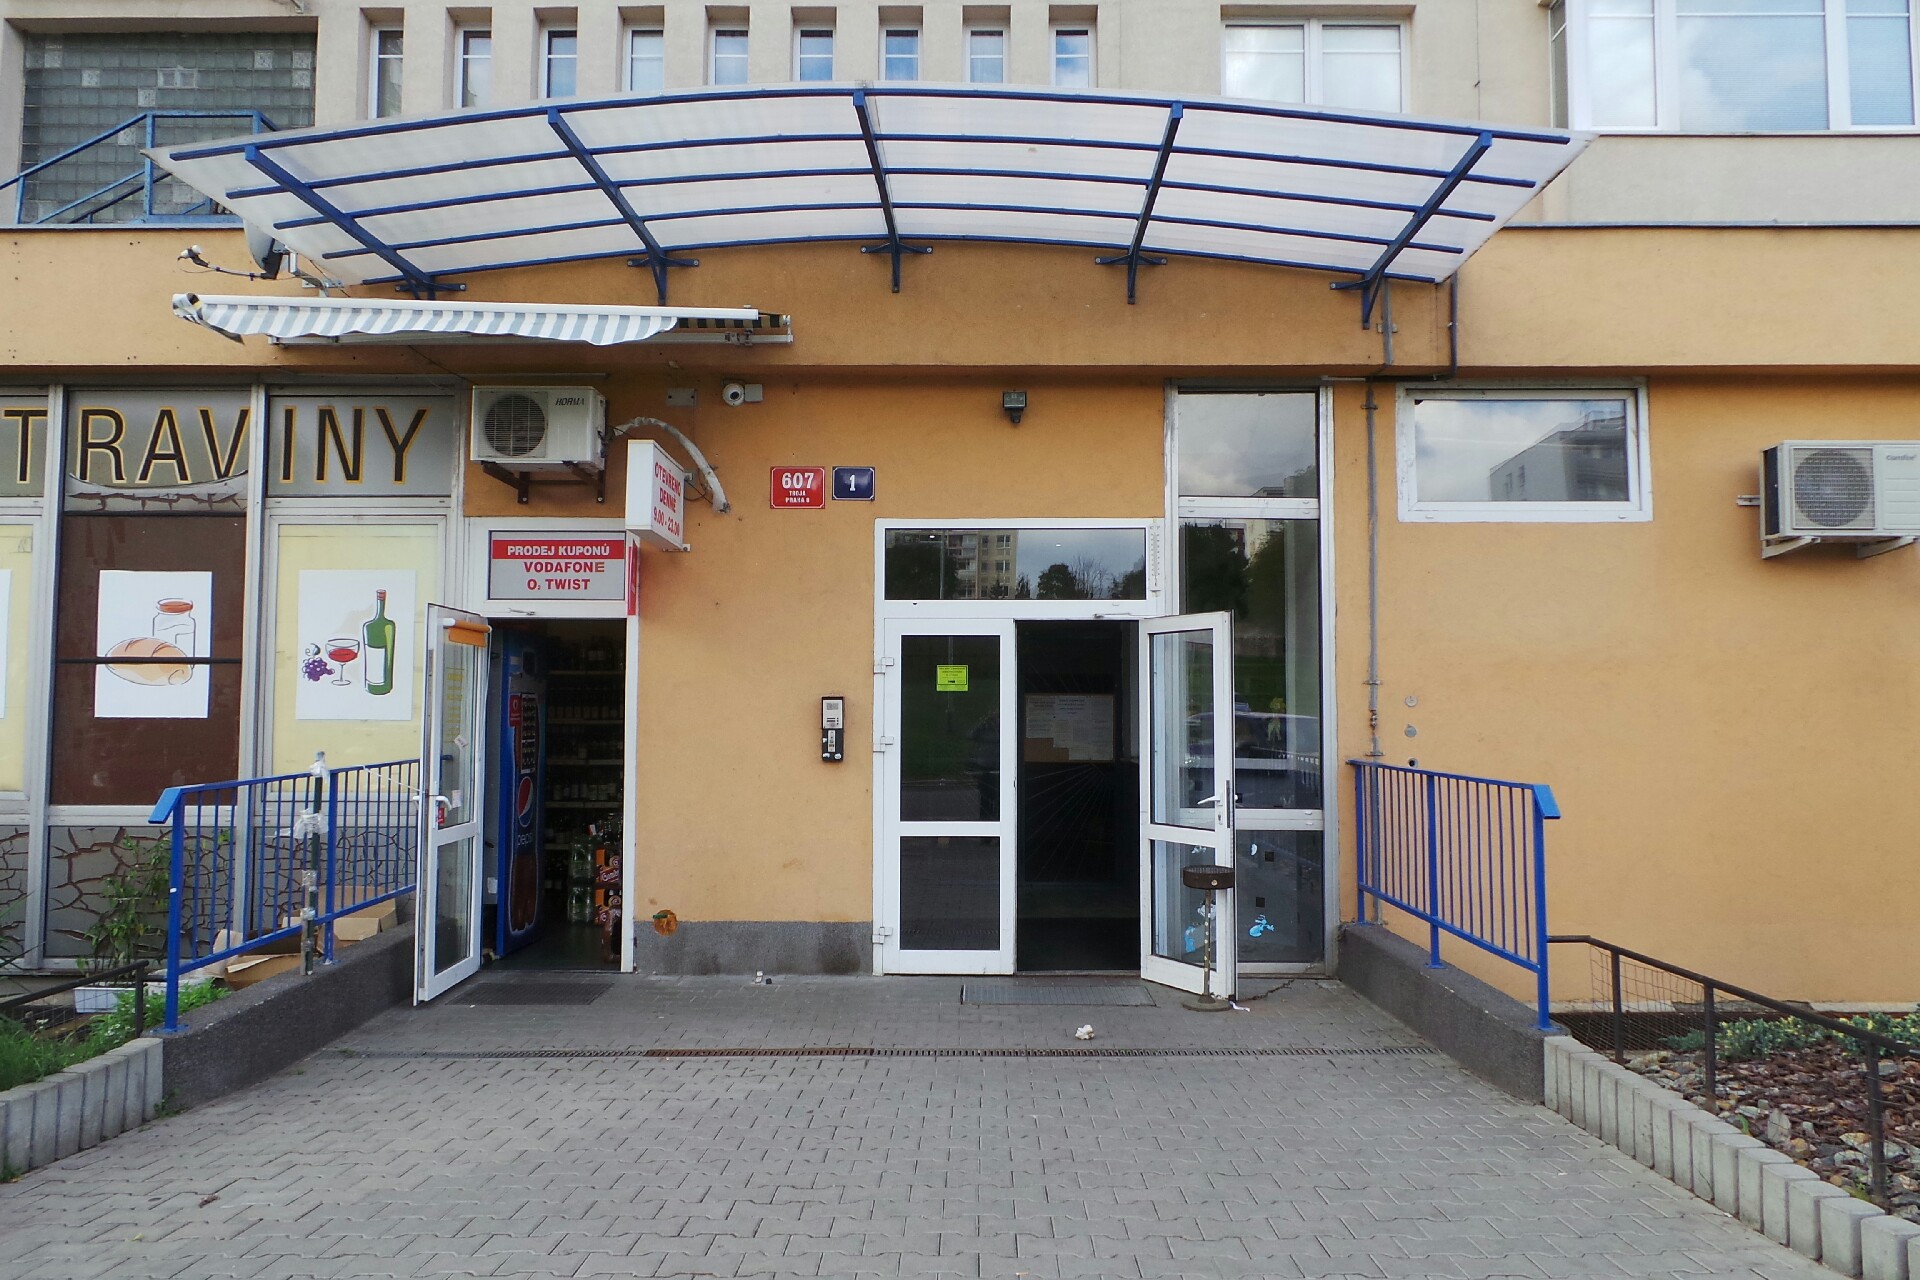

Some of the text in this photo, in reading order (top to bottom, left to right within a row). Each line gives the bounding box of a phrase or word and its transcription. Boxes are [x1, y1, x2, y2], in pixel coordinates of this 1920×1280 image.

[781, 472, 814, 489] 607
[849, 474, 856, 492] 1
[507, 543, 609, 556] PRODEJ KUPONŮ
[524, 561, 605, 573] VODAFONE
[545, 578, 591, 590] TWIST
